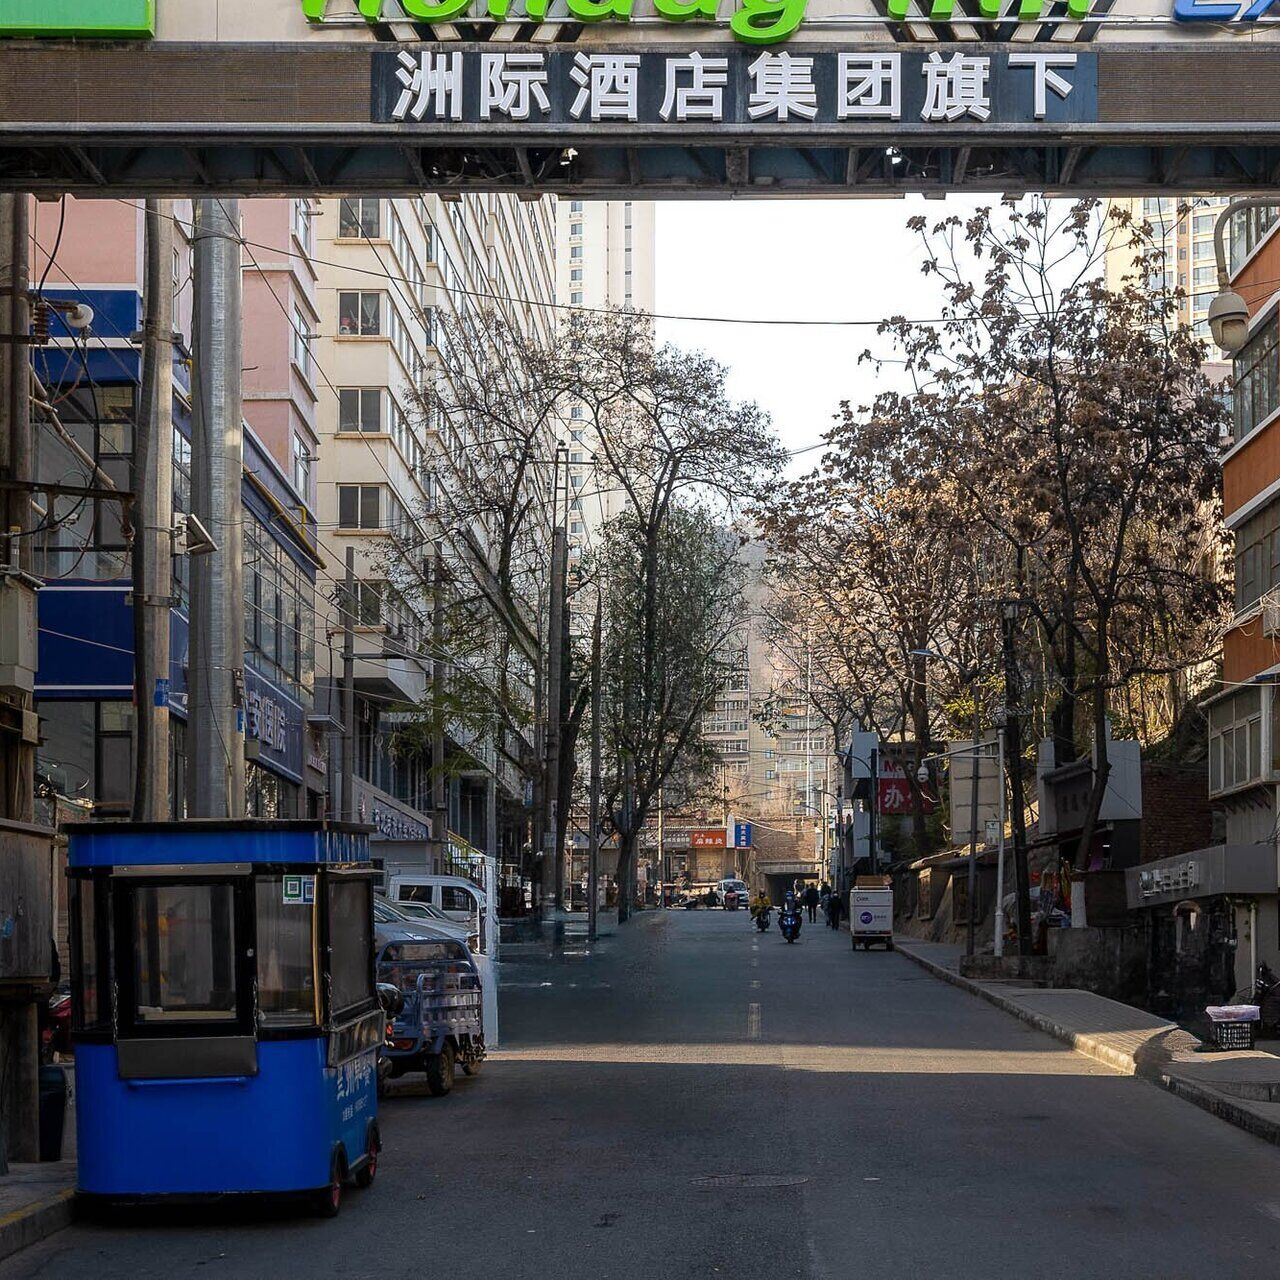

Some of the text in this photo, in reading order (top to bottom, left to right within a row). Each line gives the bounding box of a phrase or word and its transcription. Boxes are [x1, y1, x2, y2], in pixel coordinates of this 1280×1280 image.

[393, 51, 1077, 122] 洲际酒店集团旗下
